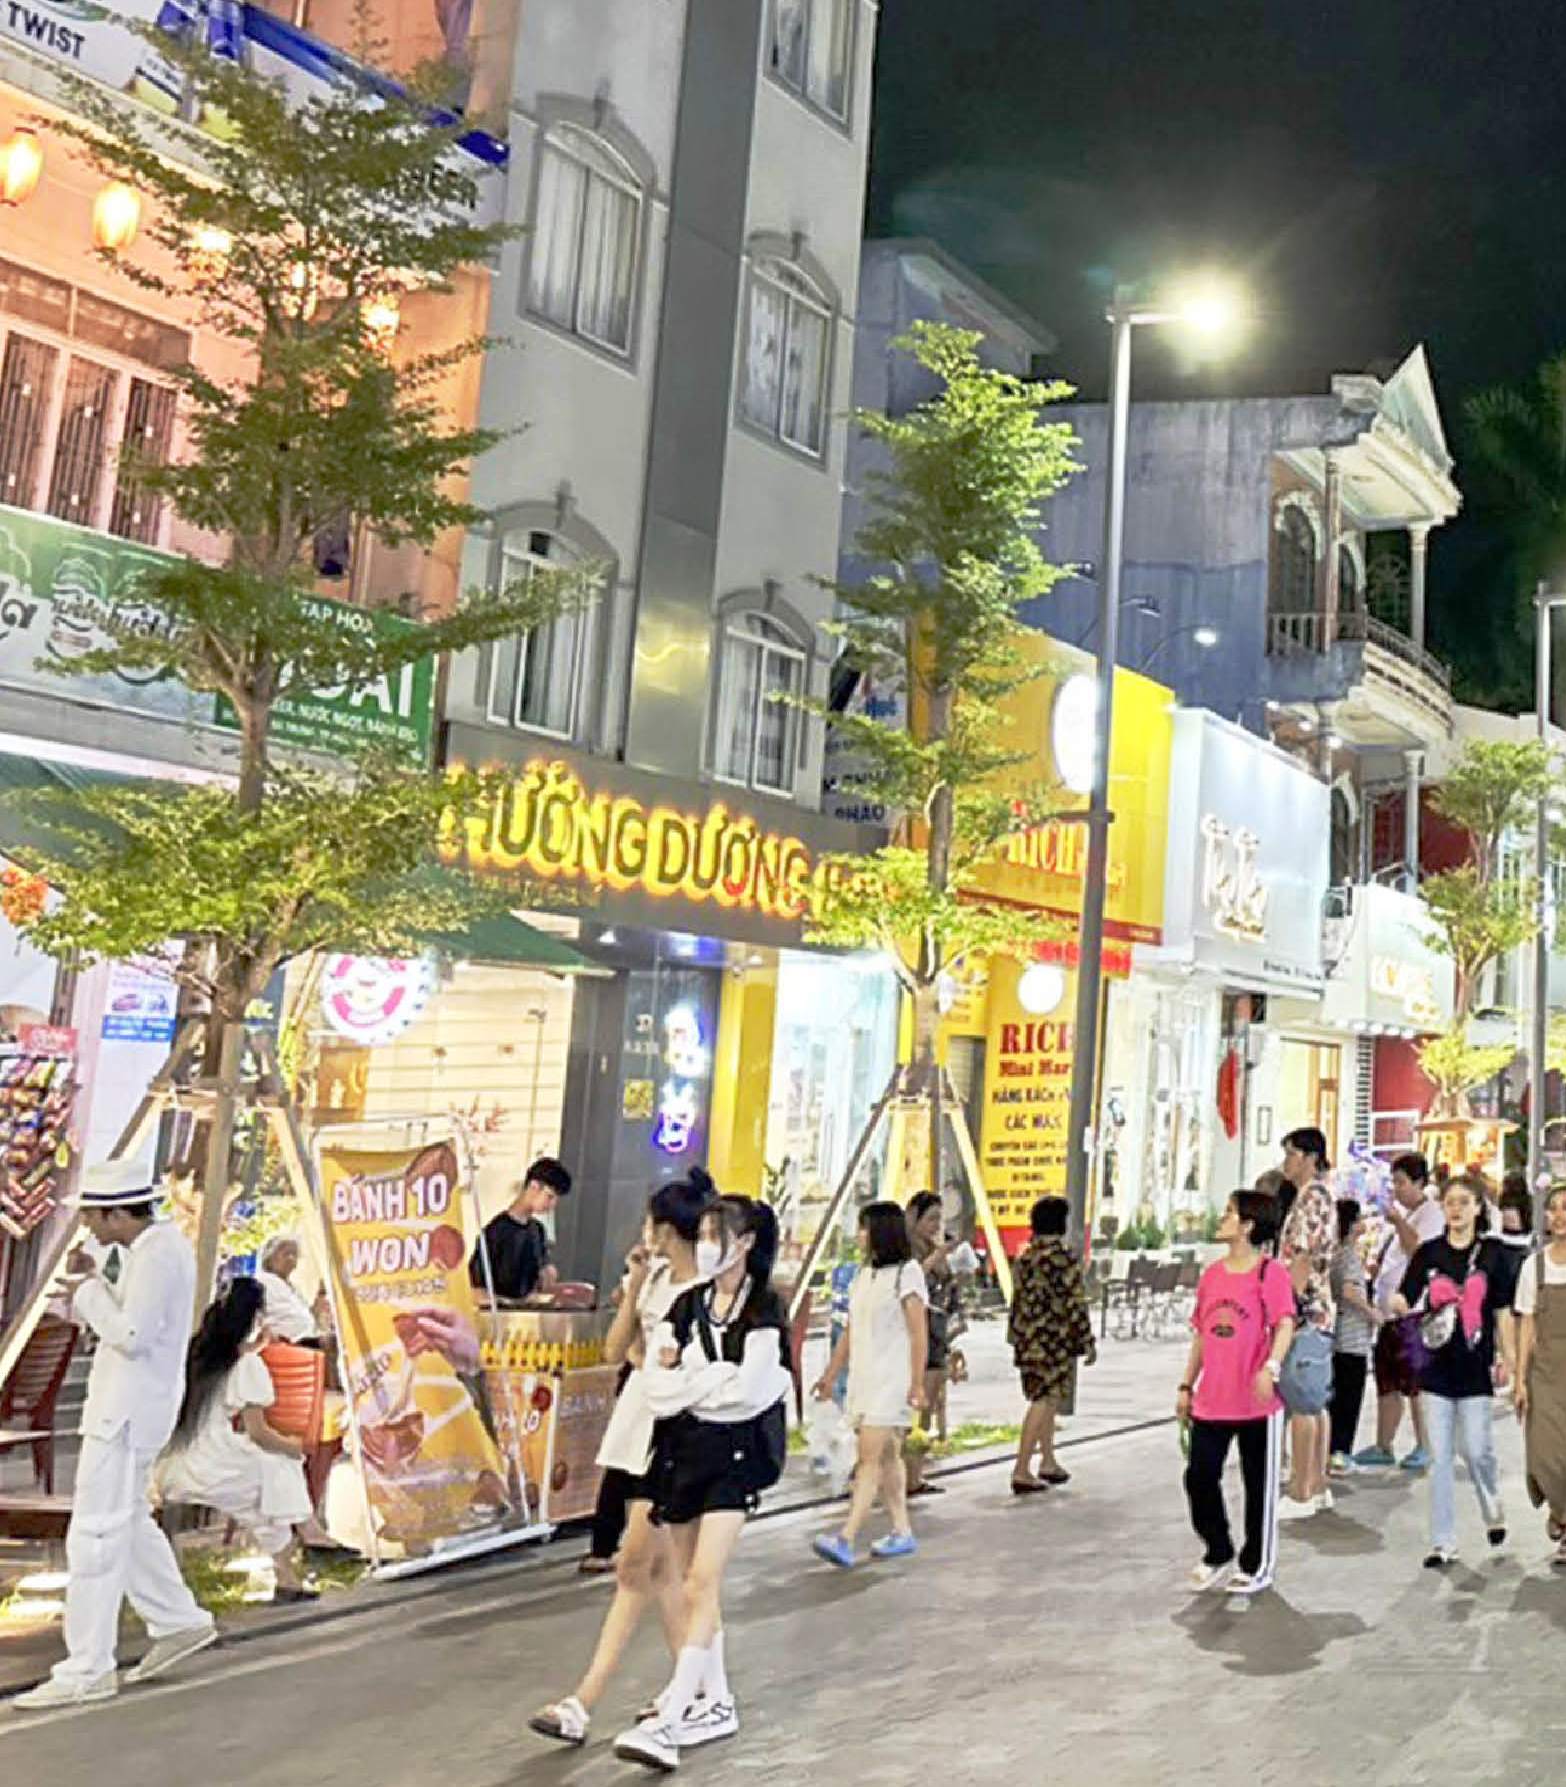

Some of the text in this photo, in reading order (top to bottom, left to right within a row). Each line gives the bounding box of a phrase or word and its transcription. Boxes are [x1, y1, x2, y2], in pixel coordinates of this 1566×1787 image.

[8, 1, 85, 57] TWIST
[1039, 1059, 1071, 1075] Mar
[332, 1172, 448, 1222] BÁNH 10
[351, 1232, 431, 1276] WON
